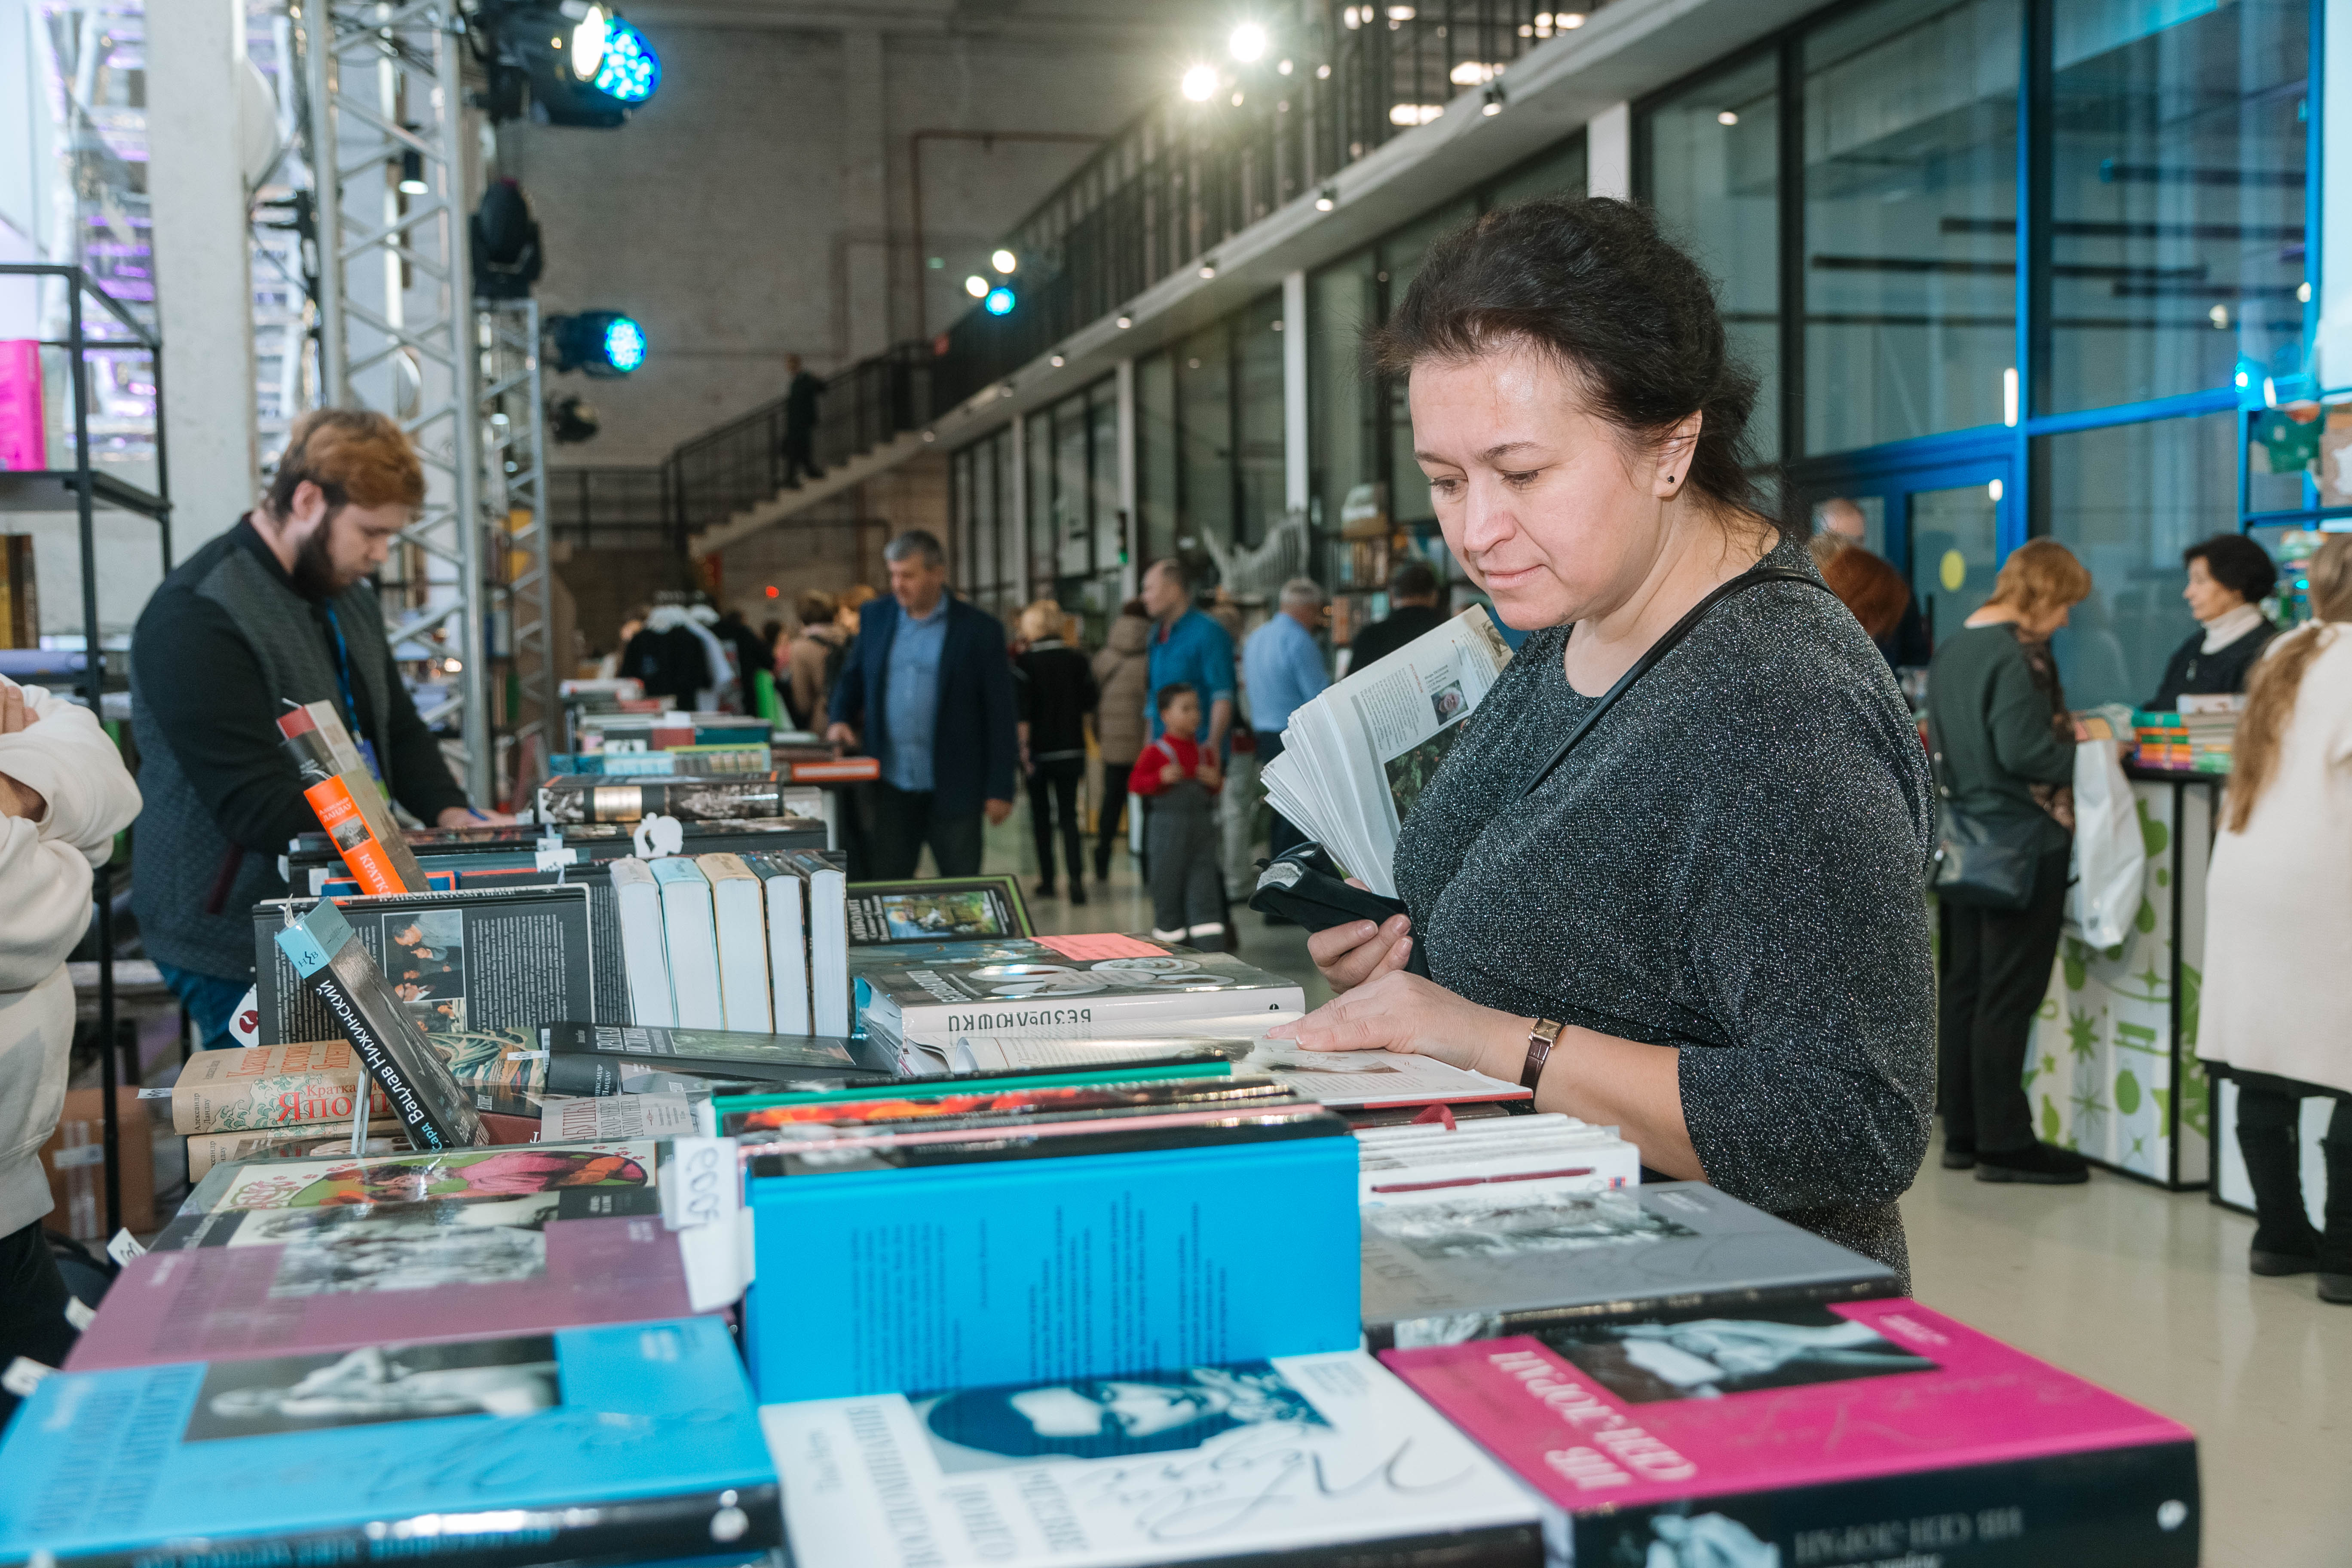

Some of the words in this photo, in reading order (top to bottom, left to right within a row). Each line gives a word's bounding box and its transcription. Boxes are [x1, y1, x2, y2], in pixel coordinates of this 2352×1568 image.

[358, 852, 392, 894] КРАТК
[316, 980, 388, 1071] Нижинский
[307, 1081, 356, 1099] Кратка
[382, 1065, 425, 1124] Вацлав
[595, 1064, 603, 1096] ЛЕКСАНДР
[563, 1098, 597, 1140] АБУШКА,
